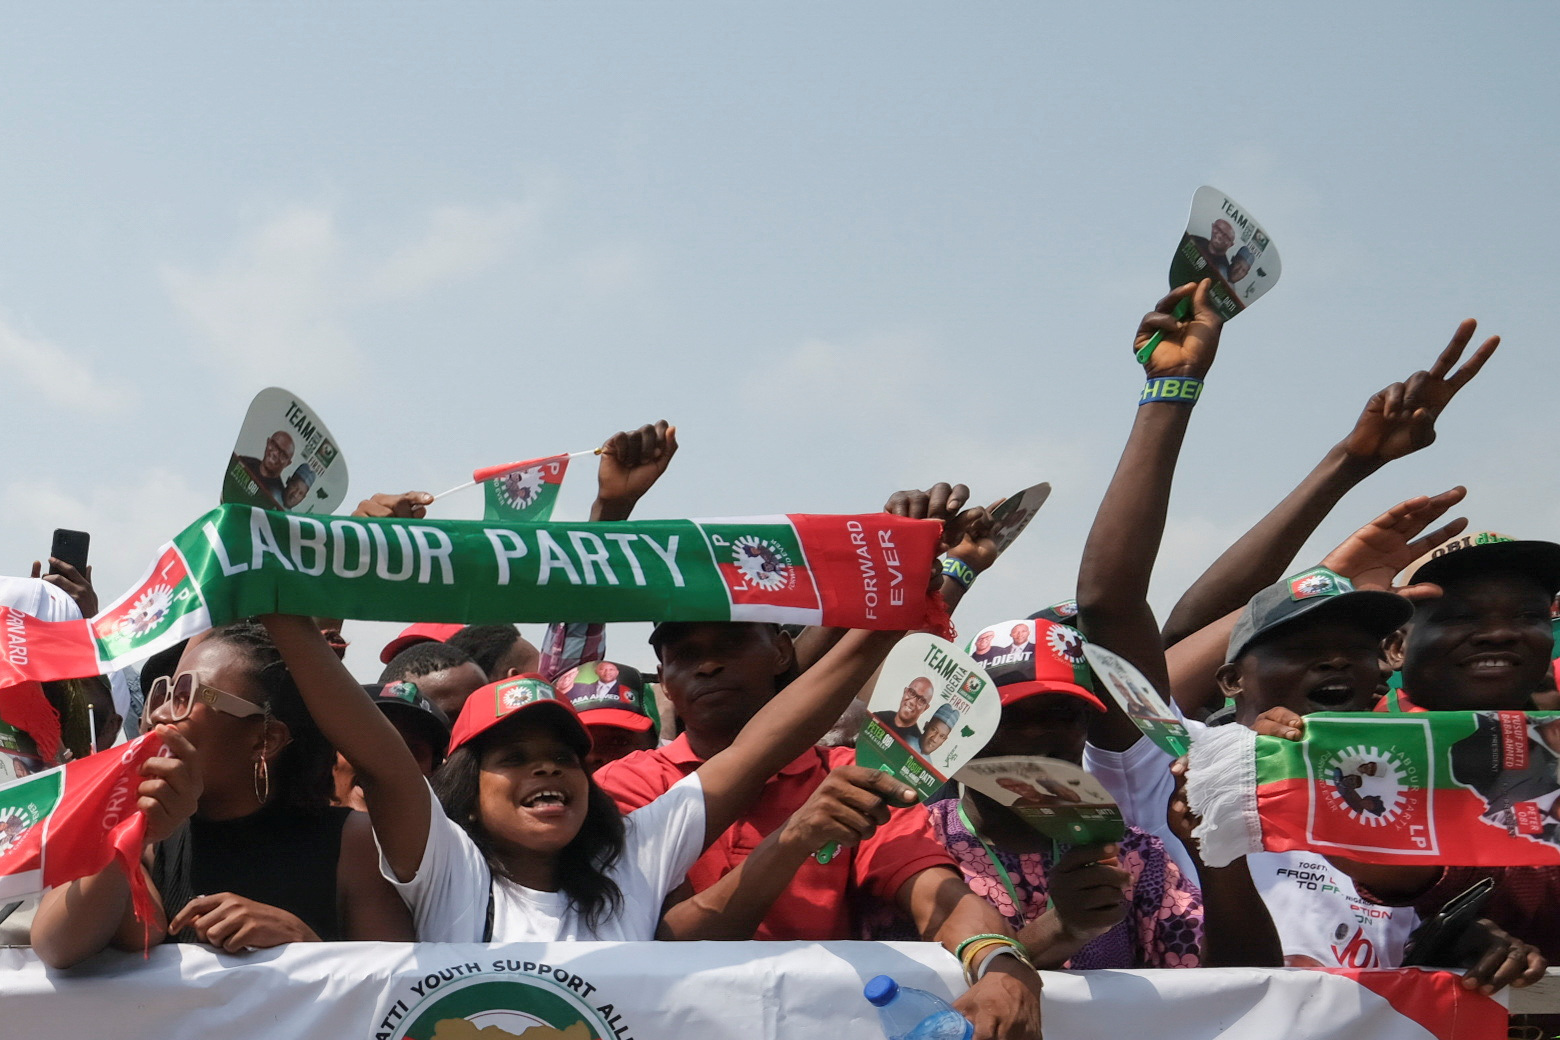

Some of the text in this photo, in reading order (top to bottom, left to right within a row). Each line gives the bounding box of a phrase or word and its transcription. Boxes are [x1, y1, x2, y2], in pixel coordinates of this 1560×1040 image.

[1219, 198, 1249, 229] TEAM
[285, 401, 317, 442] TEAM
[200, 506, 686, 587] LABOUR PARTY
[846, 520, 878, 619] FORWARD
[878, 529, 904, 606] EVER
[923, 643, 958, 681] TEAM
[941, 667, 967, 700] NIGERIA
[948, 694, 971, 715] FIRST!
[1501, 713, 1514, 768] BABA-AHMED
[1515, 741, 1524, 767] DATTI
[919, 769, 936, 787] DATTI
[1390, 745, 1420, 831] LABOUR PARTY
[1526, 805, 1539, 831] PETER
[1409, 824, 1427, 848] LP
[1276, 868, 1326, 882] FROM
[1298, 861, 1328, 872] TOGET
[1296, 880, 1318, 891] TO
[410, 961, 482, 999] YOUTH
[492, 959, 597, 999] SUPPORT
